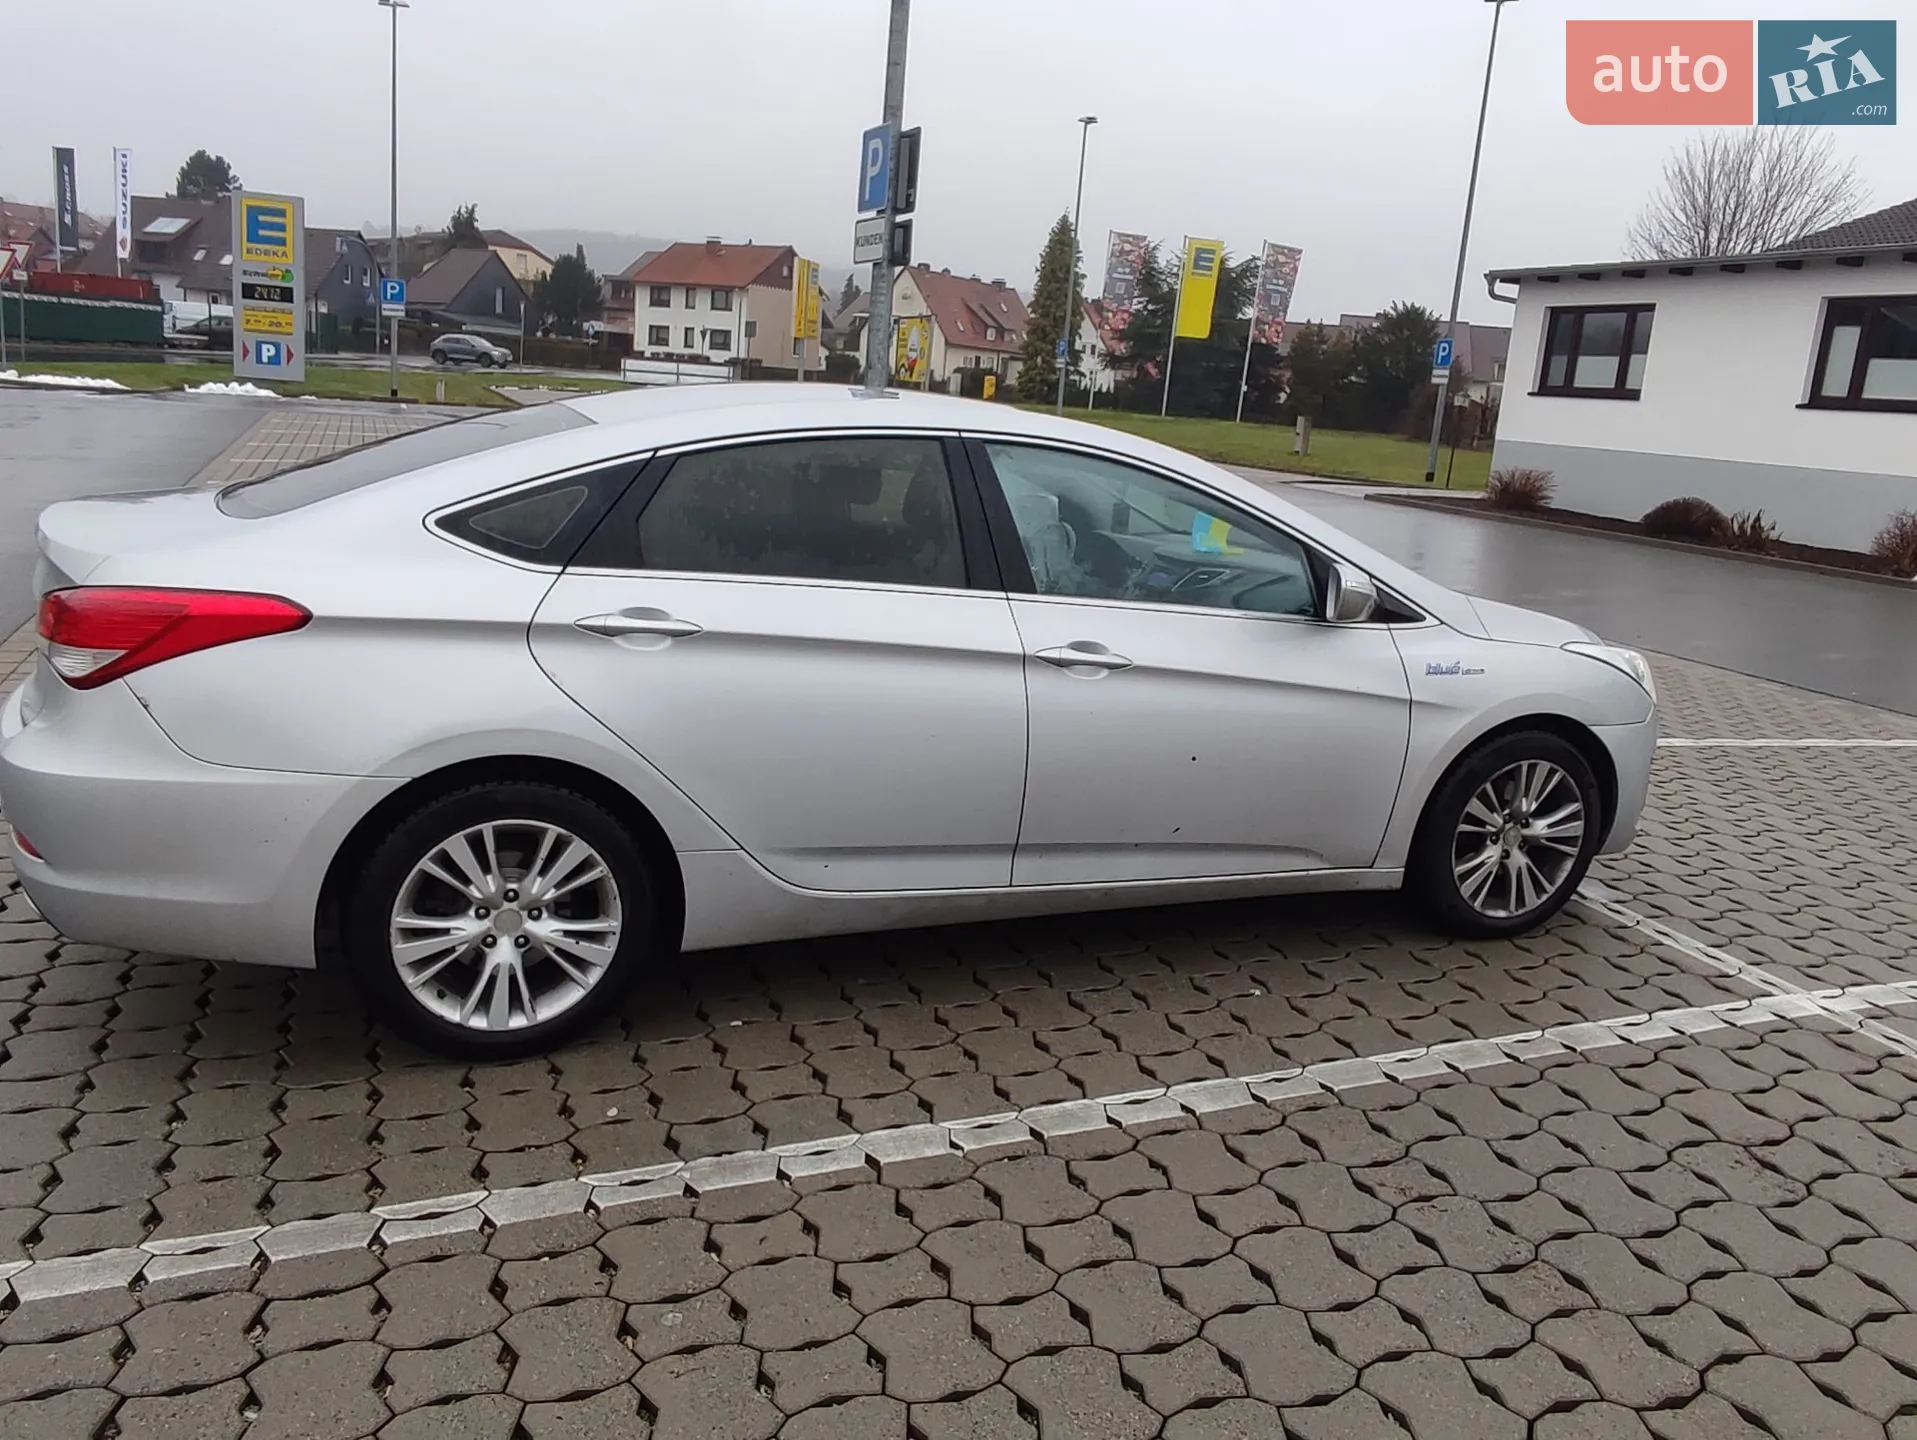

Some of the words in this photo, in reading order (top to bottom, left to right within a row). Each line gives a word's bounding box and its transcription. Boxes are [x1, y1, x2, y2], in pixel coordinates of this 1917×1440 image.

[863, 138, 884, 202] P
[120, 152, 129, 230] SUZUKI
[246, 203, 288, 247] E
[246, 247, 289, 259] EDEKA
[386, 281, 400, 300] P
[261, 343, 276, 364] P
[1437, 342, 1449, 364] P
